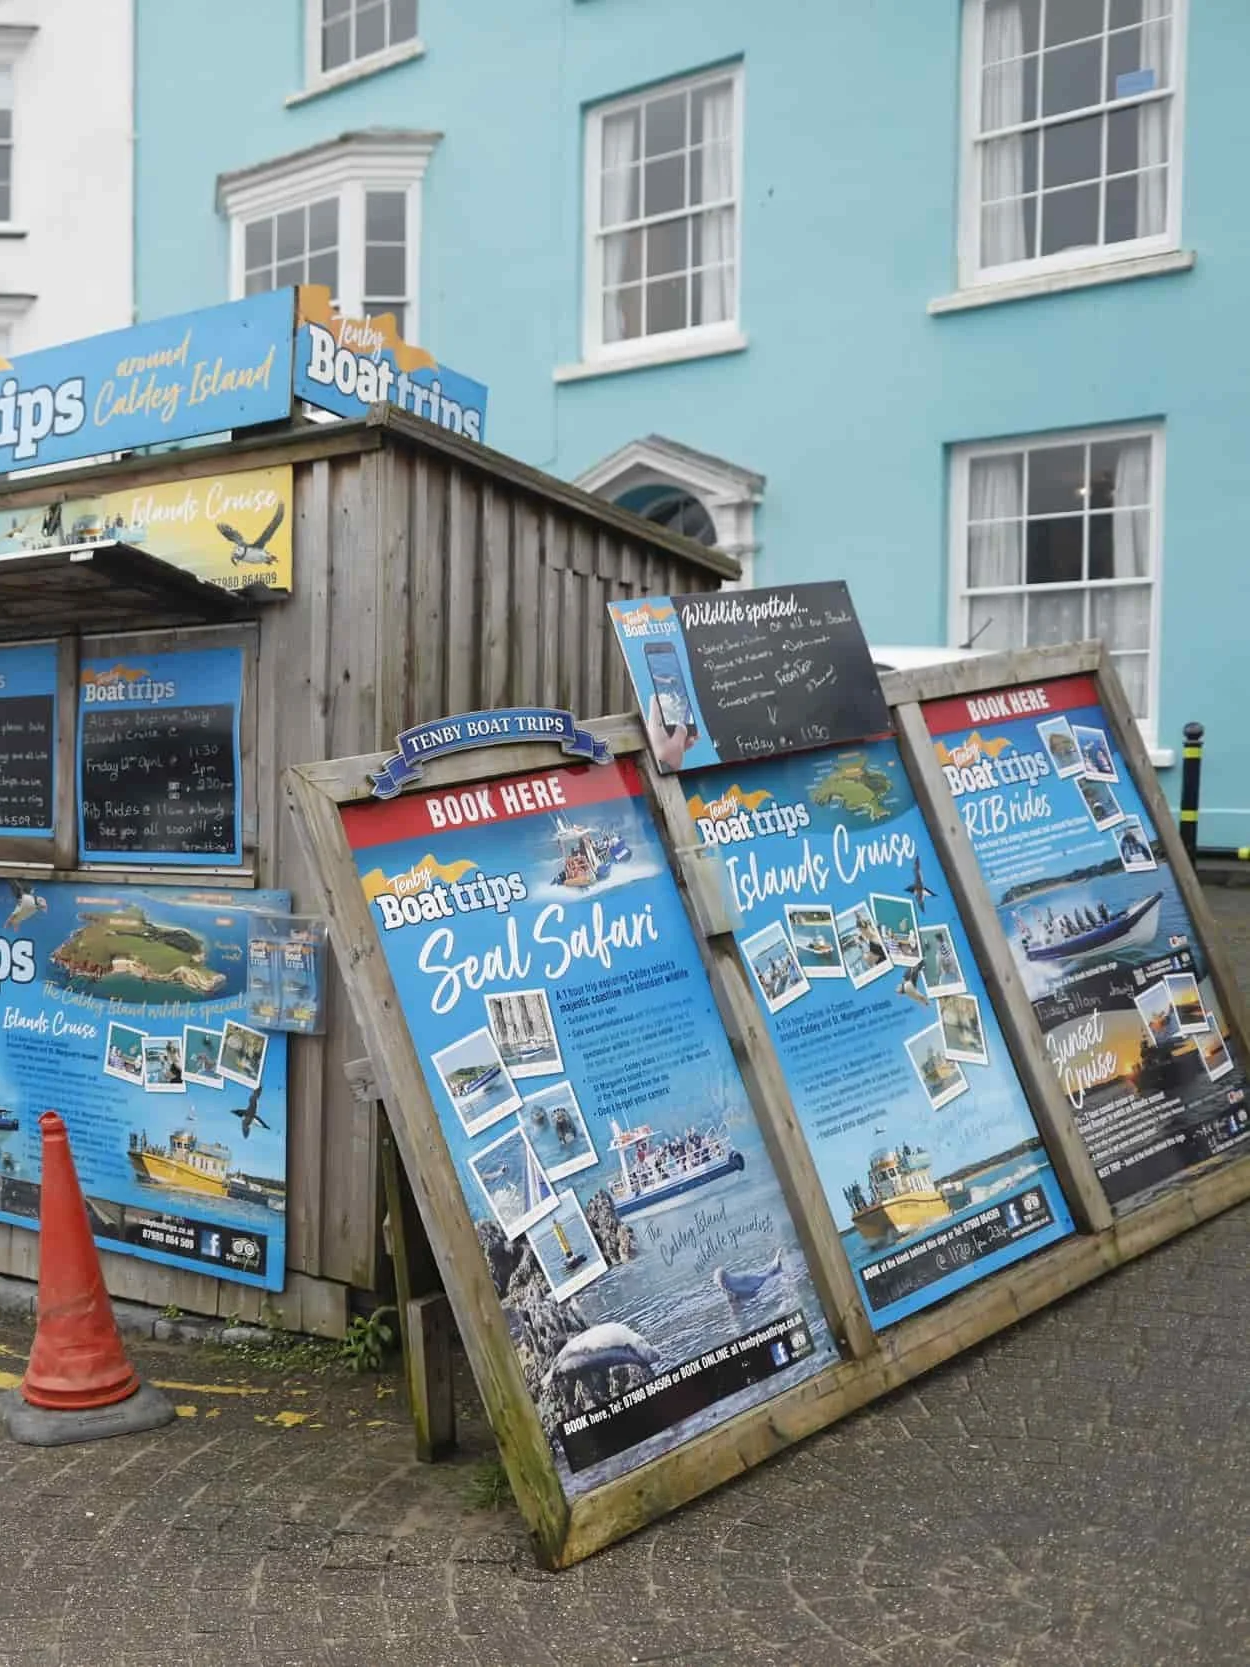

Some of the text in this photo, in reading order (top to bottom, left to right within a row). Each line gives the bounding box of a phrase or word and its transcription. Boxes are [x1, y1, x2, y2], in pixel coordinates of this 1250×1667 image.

[116, 328, 191, 379] around
[331, 314, 386, 362] Tenby
[94, 344, 275, 427] Caldey Island
[307, 323, 482, 444] Boat trips
[130, 480, 279, 531] Islands Cruise
[623, 621, 677, 638] Boat trips
[682, 593, 808, 631] Wildlife spotted...
[85, 678, 176, 704] Boat trips
[966, 687, 1049, 723] BOOK HERE
[408, 715, 565, 752] TENBY BOAT TRIPS
[735, 734, 775, 753] Friday
[86, 758, 119, 781] Friday
[944, 761, 998, 797] Boat
[998, 749, 1048, 788] trips
[84, 802, 101, 819] Rib
[105, 801, 139, 818] Rides
[426, 776, 566, 829] BOOK HERE
[698, 802, 811, 847] Boat trips
[707, 792, 738, 820] Tenby
[961, 790, 1052, 840] RIB rides
[100, 824, 116, 837] See
[120, 827, 137, 840] you
[144, 823, 158, 836] all
[387, 867, 432, 896] Tenby
[725, 841, 830, 914] Islands
[833, 823, 916, 886] Cruise
[375, 871, 528, 931] Boat trips
[418, 903, 659, 1015] Seal Safari
[43, 979, 198, 1021] The Caldey Island wildlife
[3, 1006, 98, 1040] Islands Cruise
[1047, 1008, 1104, 1078] Sunset
[1064, 1050, 1118, 1110] Cruise
[644, 1219, 663, 1243] The
[659, 1201, 727, 1267] Caldey Island
[693, 1231, 727, 1274] wildlife
[863, 1263, 881, 1281] BOOK
[563, 1415, 590, 1436] BOOK
[589, 1408, 612, 1426] here,
[610, 1402, 623, 1418] Tel:
[623, 1390, 646, 1410] 07980
[680, 1360, 702, 1382] BOOK
[702, 1346, 731, 1370] ONLINE
